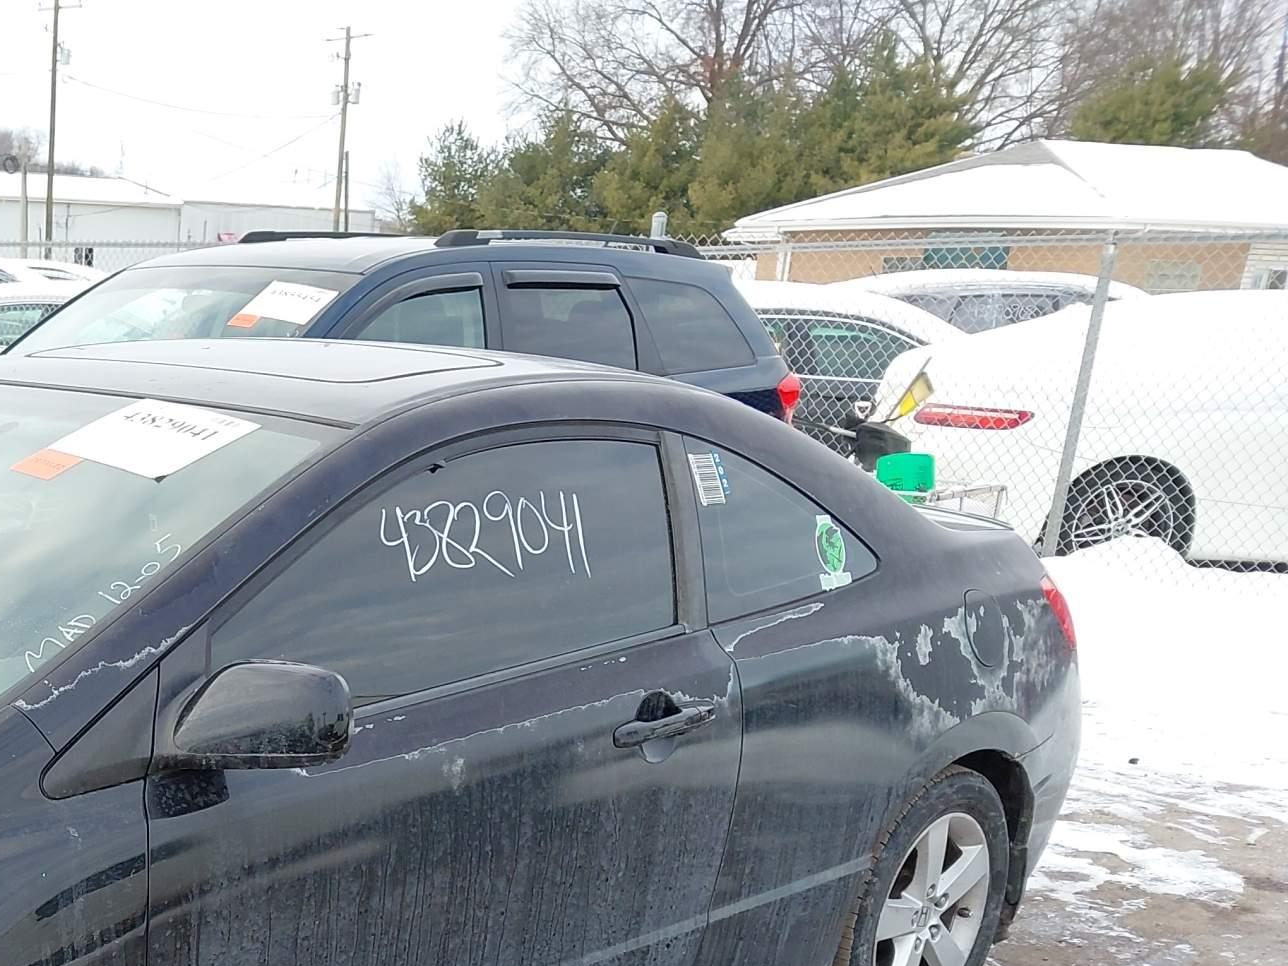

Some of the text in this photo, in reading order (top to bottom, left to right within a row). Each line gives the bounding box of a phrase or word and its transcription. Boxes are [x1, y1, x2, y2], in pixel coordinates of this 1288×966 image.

[380, 490, 592, 582] 43829041
[25, 533, 182, 673] MAD 12-05
